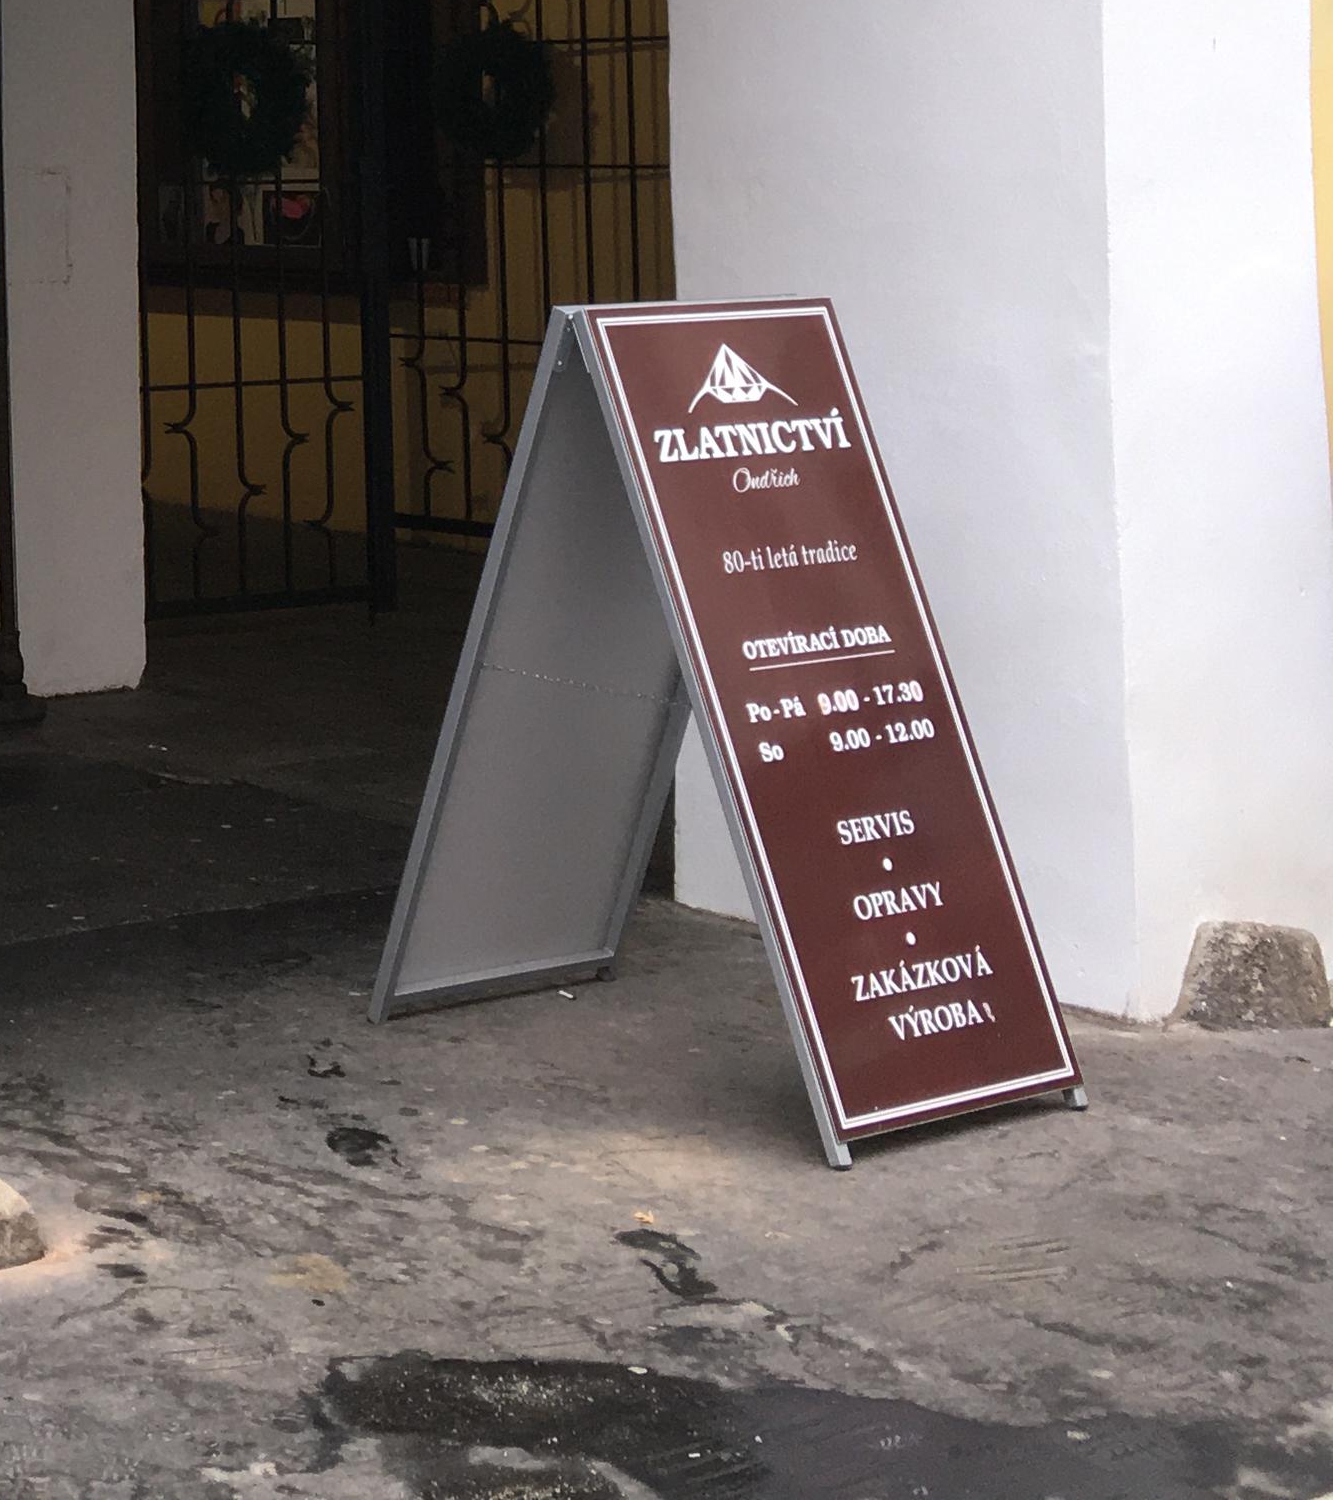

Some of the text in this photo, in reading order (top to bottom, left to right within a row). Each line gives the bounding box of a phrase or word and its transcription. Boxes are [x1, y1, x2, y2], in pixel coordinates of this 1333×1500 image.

[653, 408, 852, 463] ZLATNICTVÍ
[732, 467, 800, 493] Ondřich
[722, 539, 859, 574] 80-ti letá tradice
[741, 624, 893, 660] OTEVÍRACÍ DOBA
[816, 688, 861, 716] 9.00
[872, 680, 925, 706] 17.30
[758, 741, 786, 764] So
[828, 727, 872, 753] 9.00
[884, 718, 936, 744] 12.00
[835, 809, 916, 846] SERVIS
[852, 881, 944, 921] OPRAVY
[850, 944, 994, 1002] ZAKÁZKOVÁ
[887, 999, 986, 1042] VÝROBA
